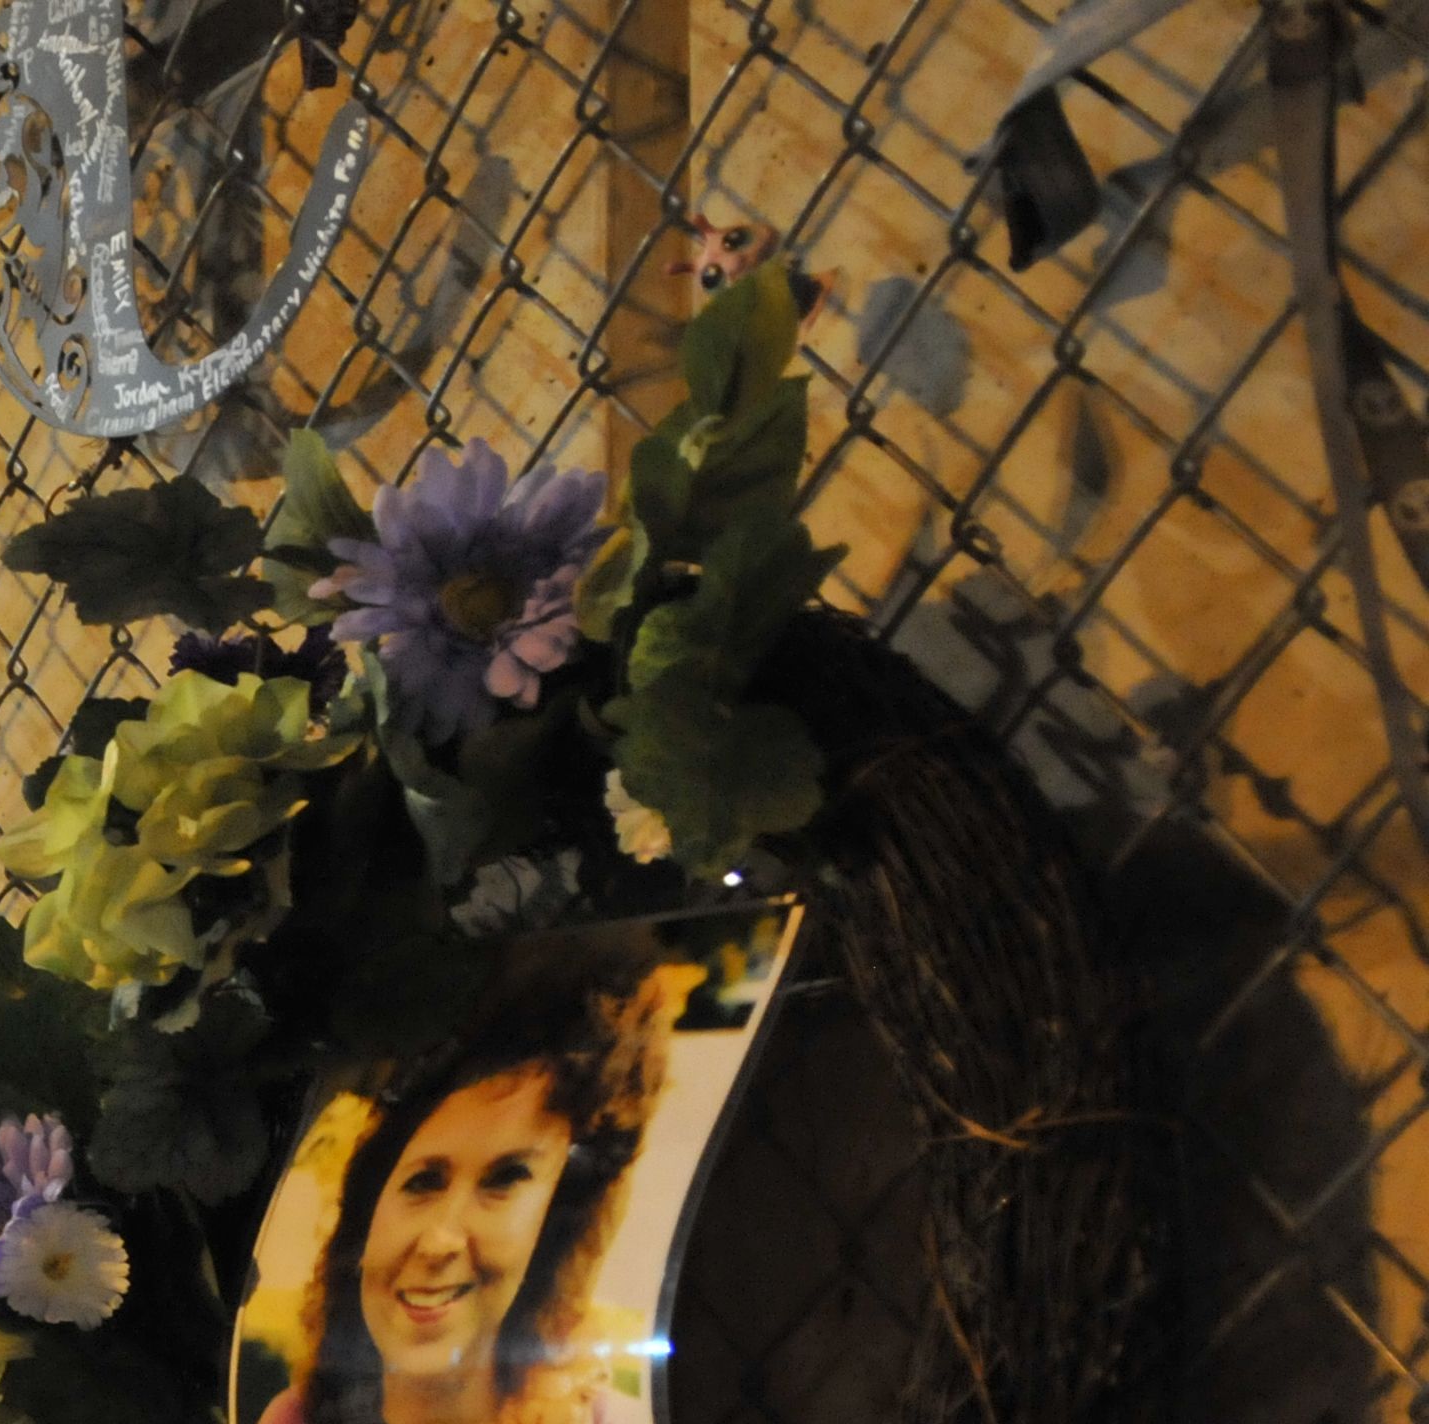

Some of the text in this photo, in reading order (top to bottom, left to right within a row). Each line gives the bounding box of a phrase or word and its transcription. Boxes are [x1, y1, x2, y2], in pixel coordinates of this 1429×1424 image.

[85, 391, 195, 436] Cunningham
[202, 287, 302, 402] Elementary
[298, 193, 347, 282] Wichita
[333, 116, 368, 183] Falls
